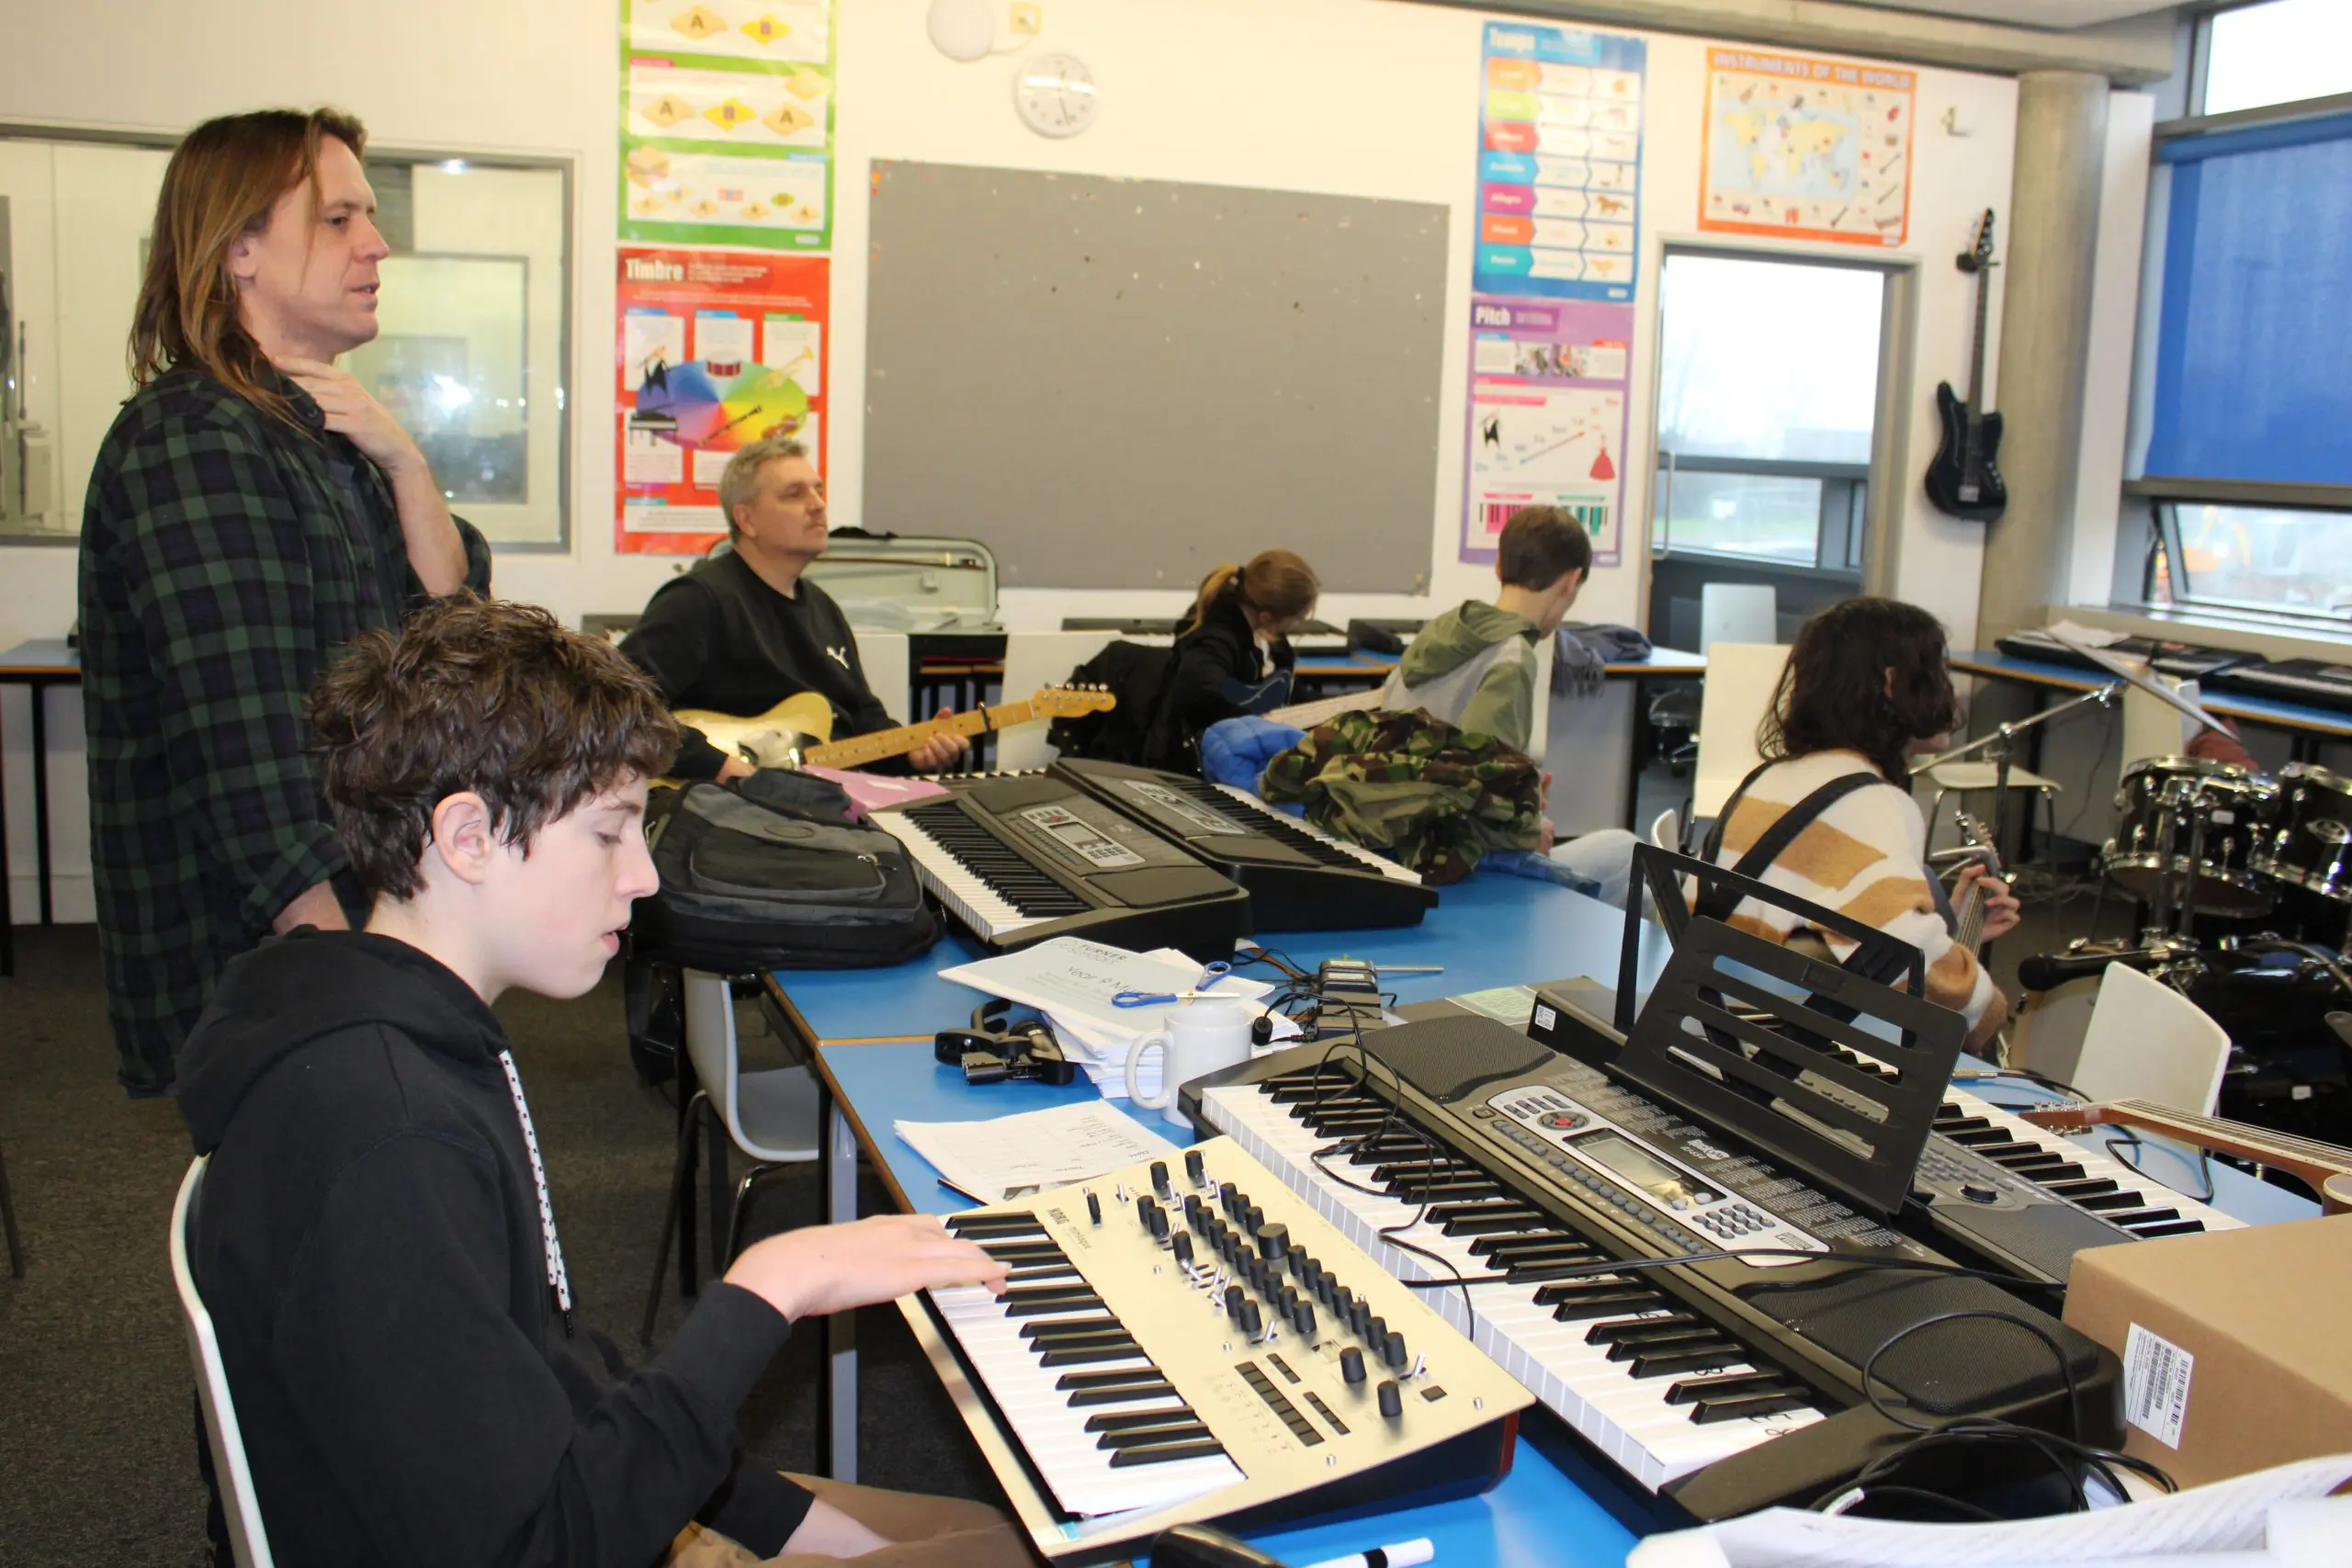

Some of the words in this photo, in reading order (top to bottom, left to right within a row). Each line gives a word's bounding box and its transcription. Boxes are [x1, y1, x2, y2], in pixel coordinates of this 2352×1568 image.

[691, 15, 704, 29] A
[1814, 64, 1831, 80] OF
[660, 101, 673, 116] A
[780, 109, 793, 124] A
[625, 258, 684, 281] Timbre
[1475, 305, 1510, 326] Pitch
[1080, 943, 1127, 961] TURNER
[1066, 966, 1098, 980] Year
[1047, 1207, 1070, 1226] KORG
